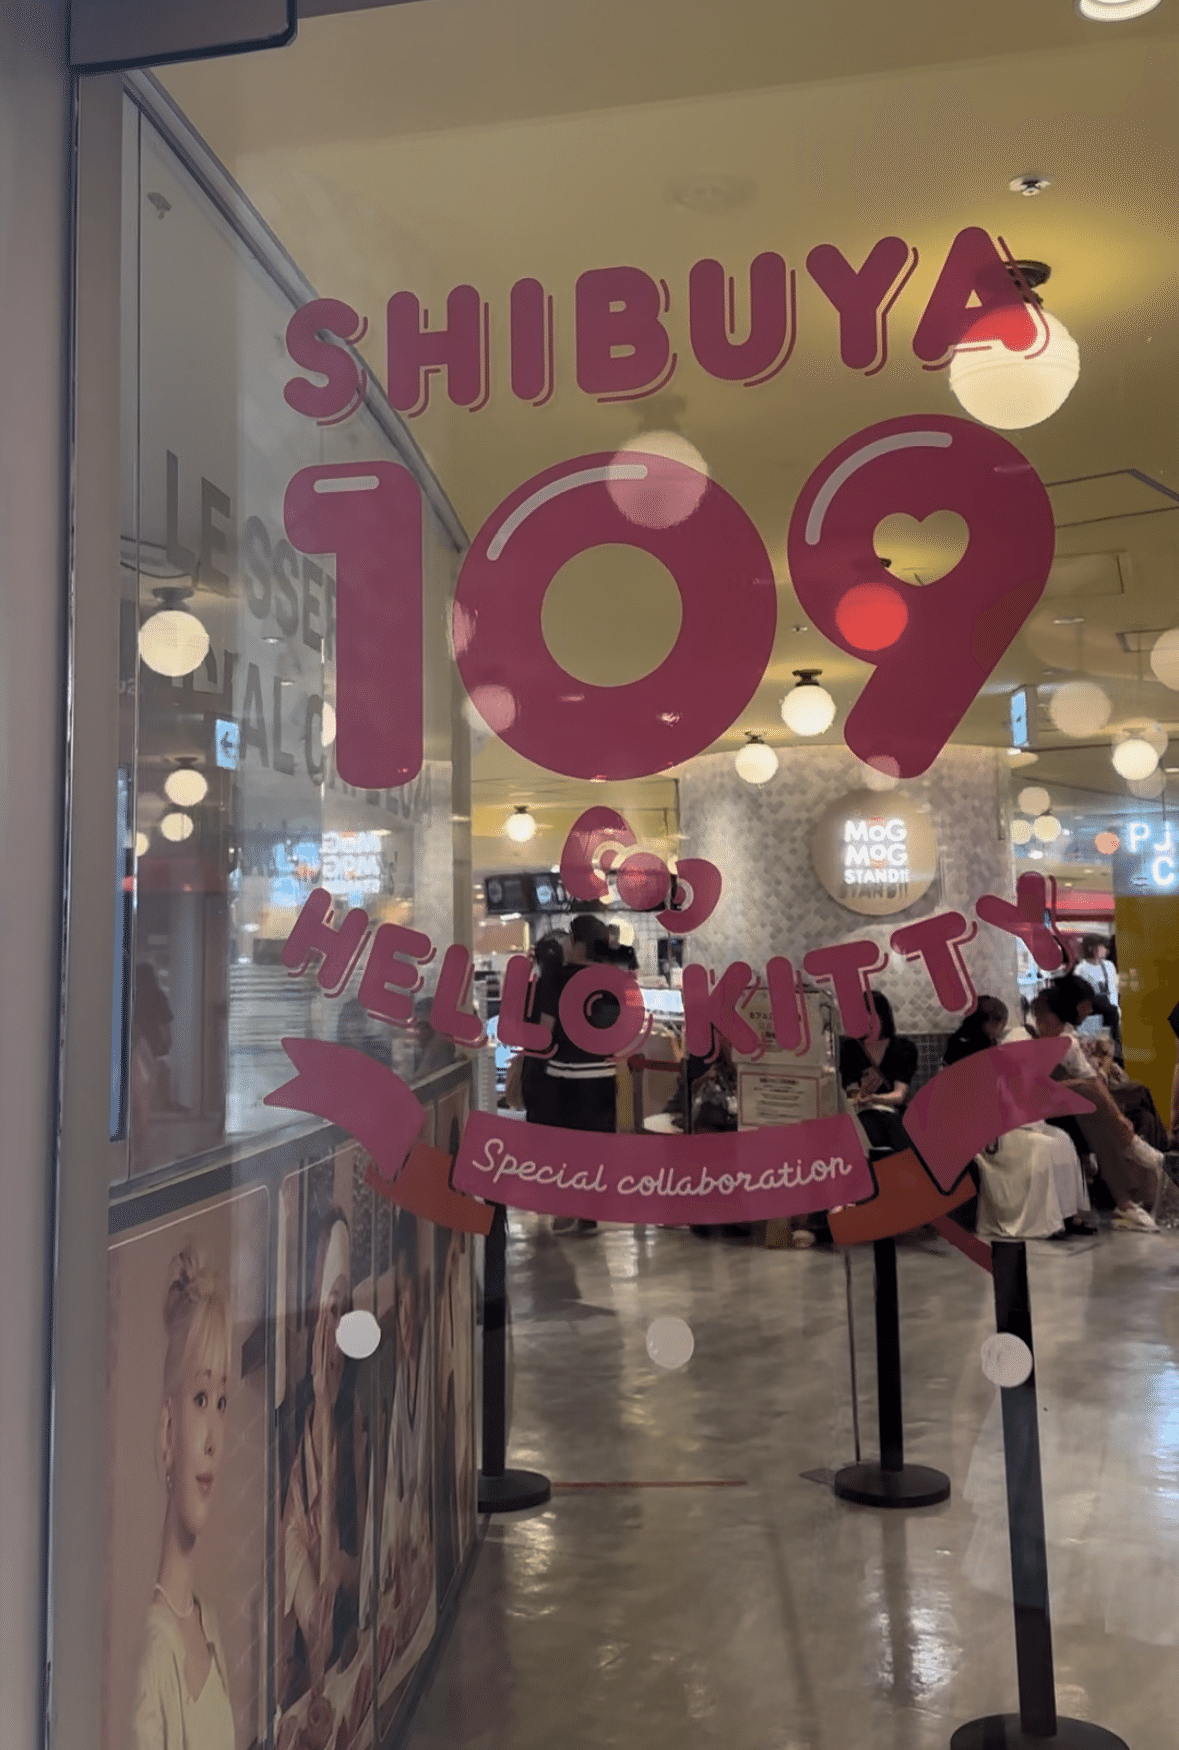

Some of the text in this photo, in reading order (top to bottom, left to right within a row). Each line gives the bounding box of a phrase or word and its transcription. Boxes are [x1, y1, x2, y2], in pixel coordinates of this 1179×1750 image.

[284, 227, 1050, 425] SHIBUYA
[284, 414, 1055, 790] 109
[280, 871, 1072, 1063] HELLO KITTY
[472, 1137, 853, 1197] Special collaboration
